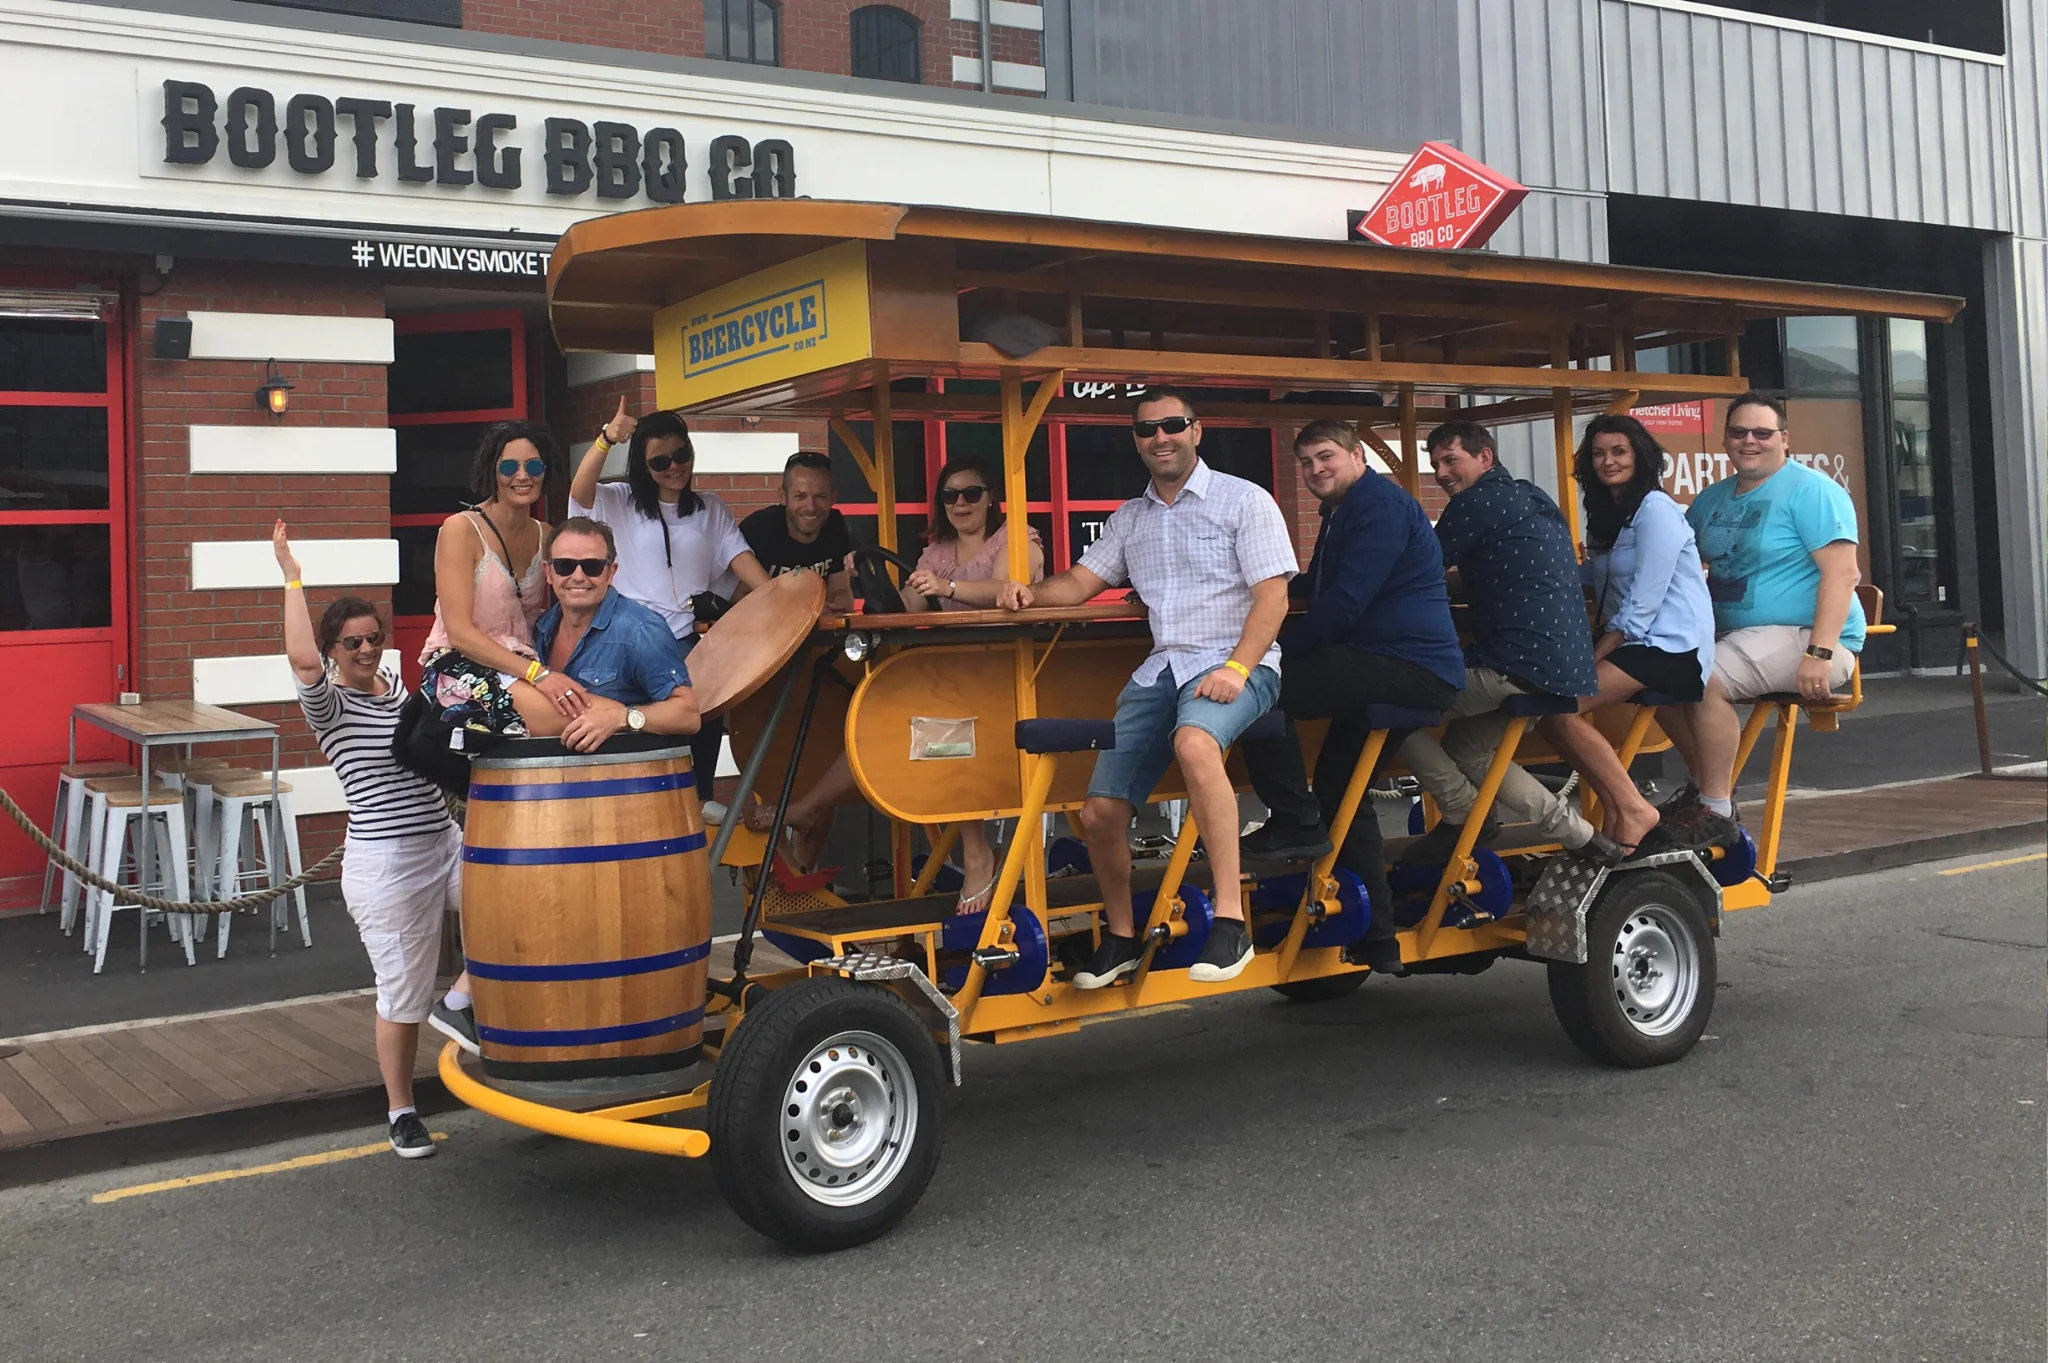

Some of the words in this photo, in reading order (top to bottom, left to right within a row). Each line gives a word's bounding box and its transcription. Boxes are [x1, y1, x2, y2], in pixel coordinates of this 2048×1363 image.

[161, 80, 522, 189] BOOTLEG
[543, 116, 688, 203] BBQ
[707, 134, 812, 201] CO
[1385, 184, 1481, 235] BOOTLEG
[1410, 228, 1435, 248] BBQ
[1437, 224, 1454, 242] CO
[688, 295, 817, 365] BEERCYCLE
[1672, 403, 1701, 421] Living
